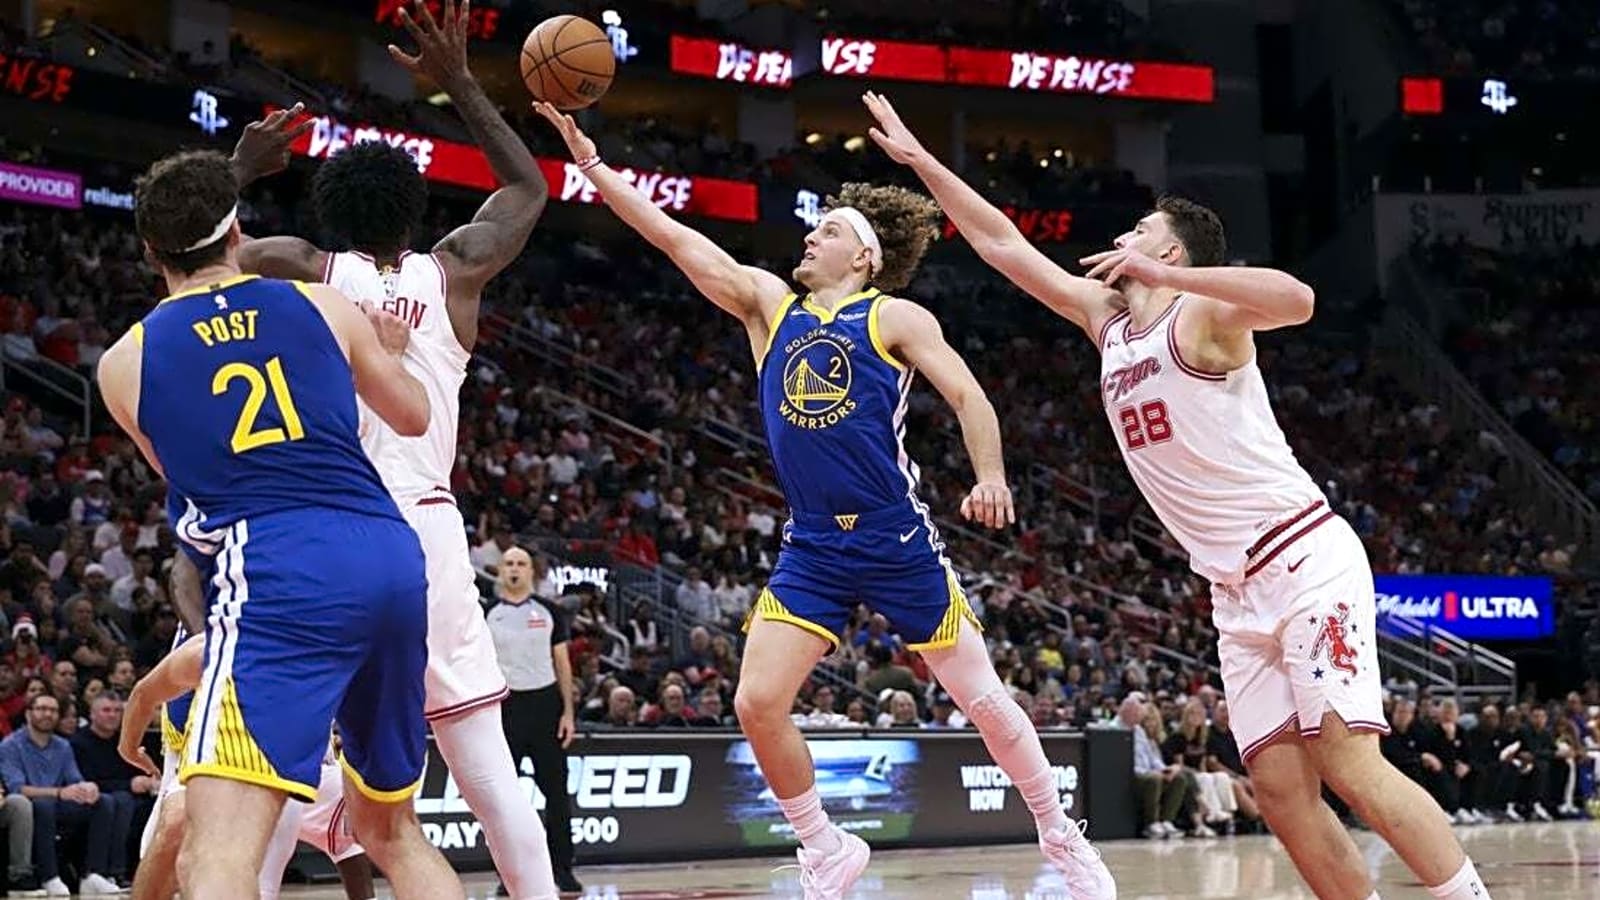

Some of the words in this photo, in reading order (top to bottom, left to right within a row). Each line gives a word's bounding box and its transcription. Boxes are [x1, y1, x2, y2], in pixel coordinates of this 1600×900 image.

[1008, 52, 1135, 93] DEFENSE
[0, 170, 76, 198] PROVIDER
[192, 310, 258, 347] POST
[784, 328, 827, 354] GOLDEN
[829, 356, 842, 378] 2
[212, 356, 305, 454] 21
[778, 399, 857, 430] WARRIORS
[1119, 398, 1174, 451] 28
[1461, 596, 1539, 619] ULTRA
[969, 788, 1006, 811] NOW
